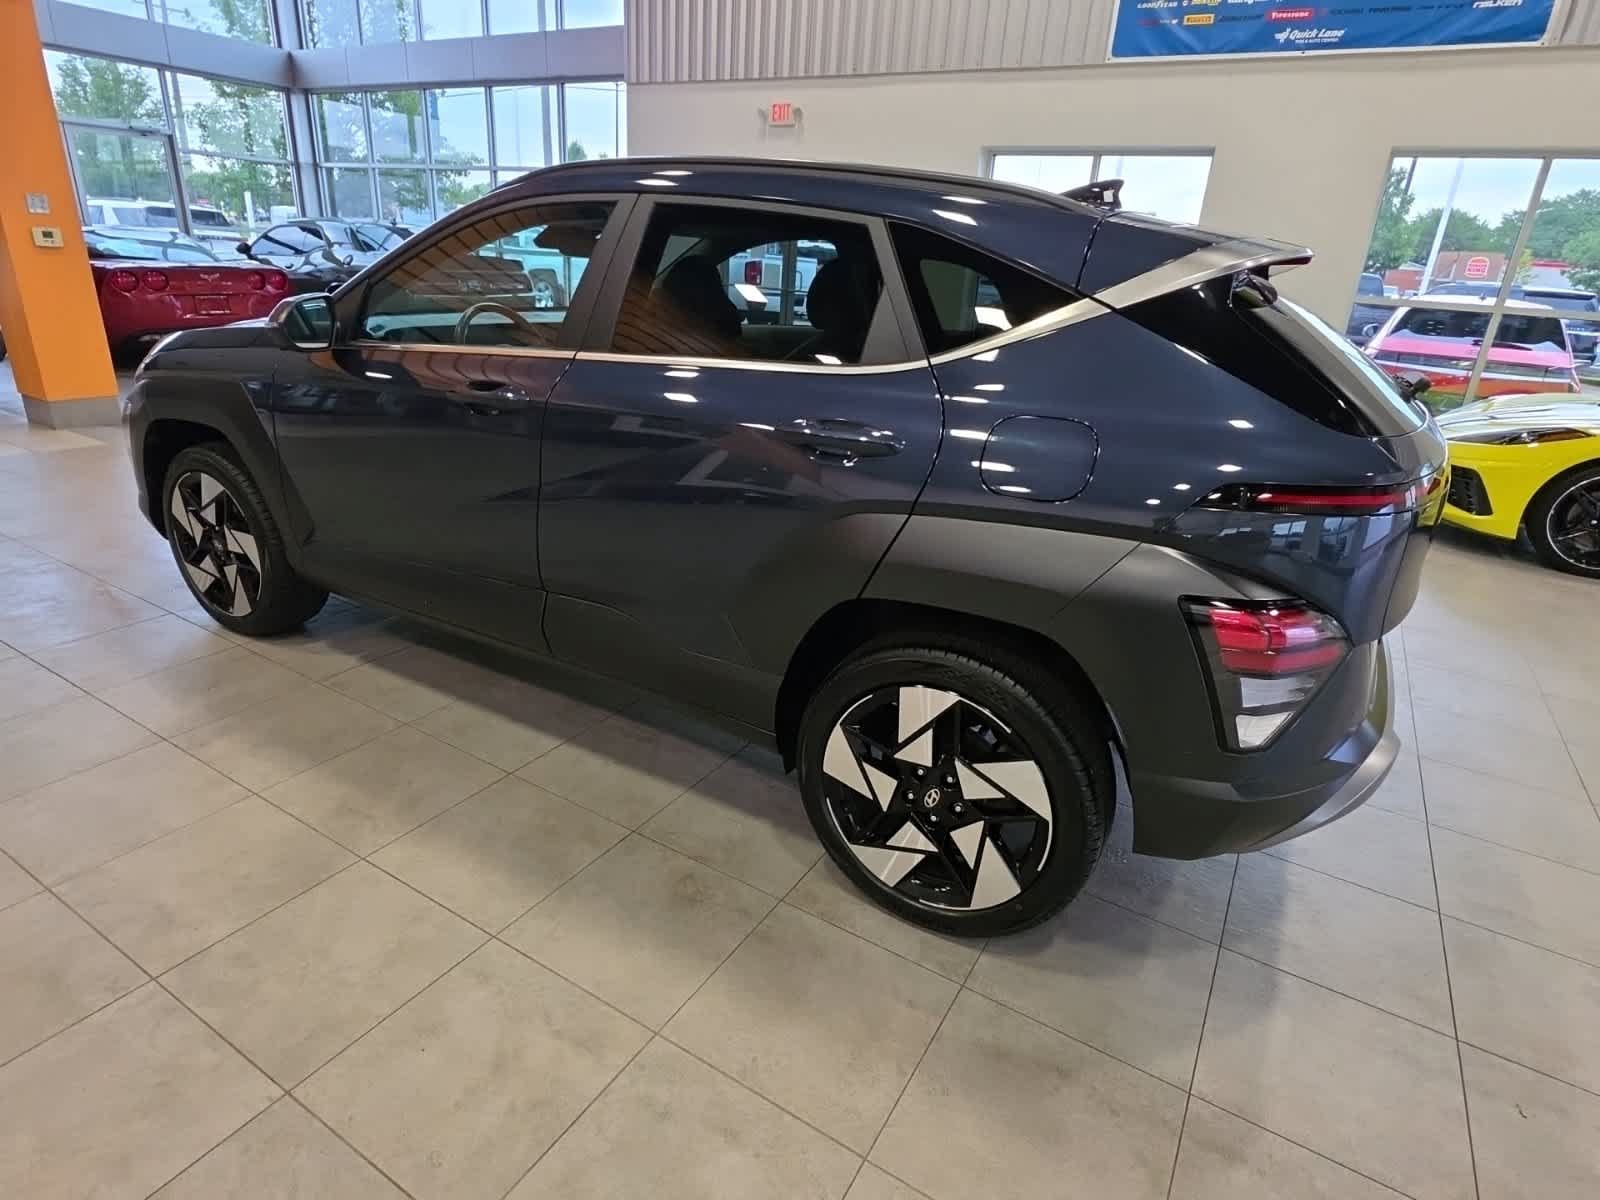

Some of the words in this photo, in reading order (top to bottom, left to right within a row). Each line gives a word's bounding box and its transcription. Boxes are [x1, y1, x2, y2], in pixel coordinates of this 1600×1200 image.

[1289, 28, 1317, 40] Quick
[1318, 28, 1345, 38] Lane
[772, 103, 791, 121] EXIT
